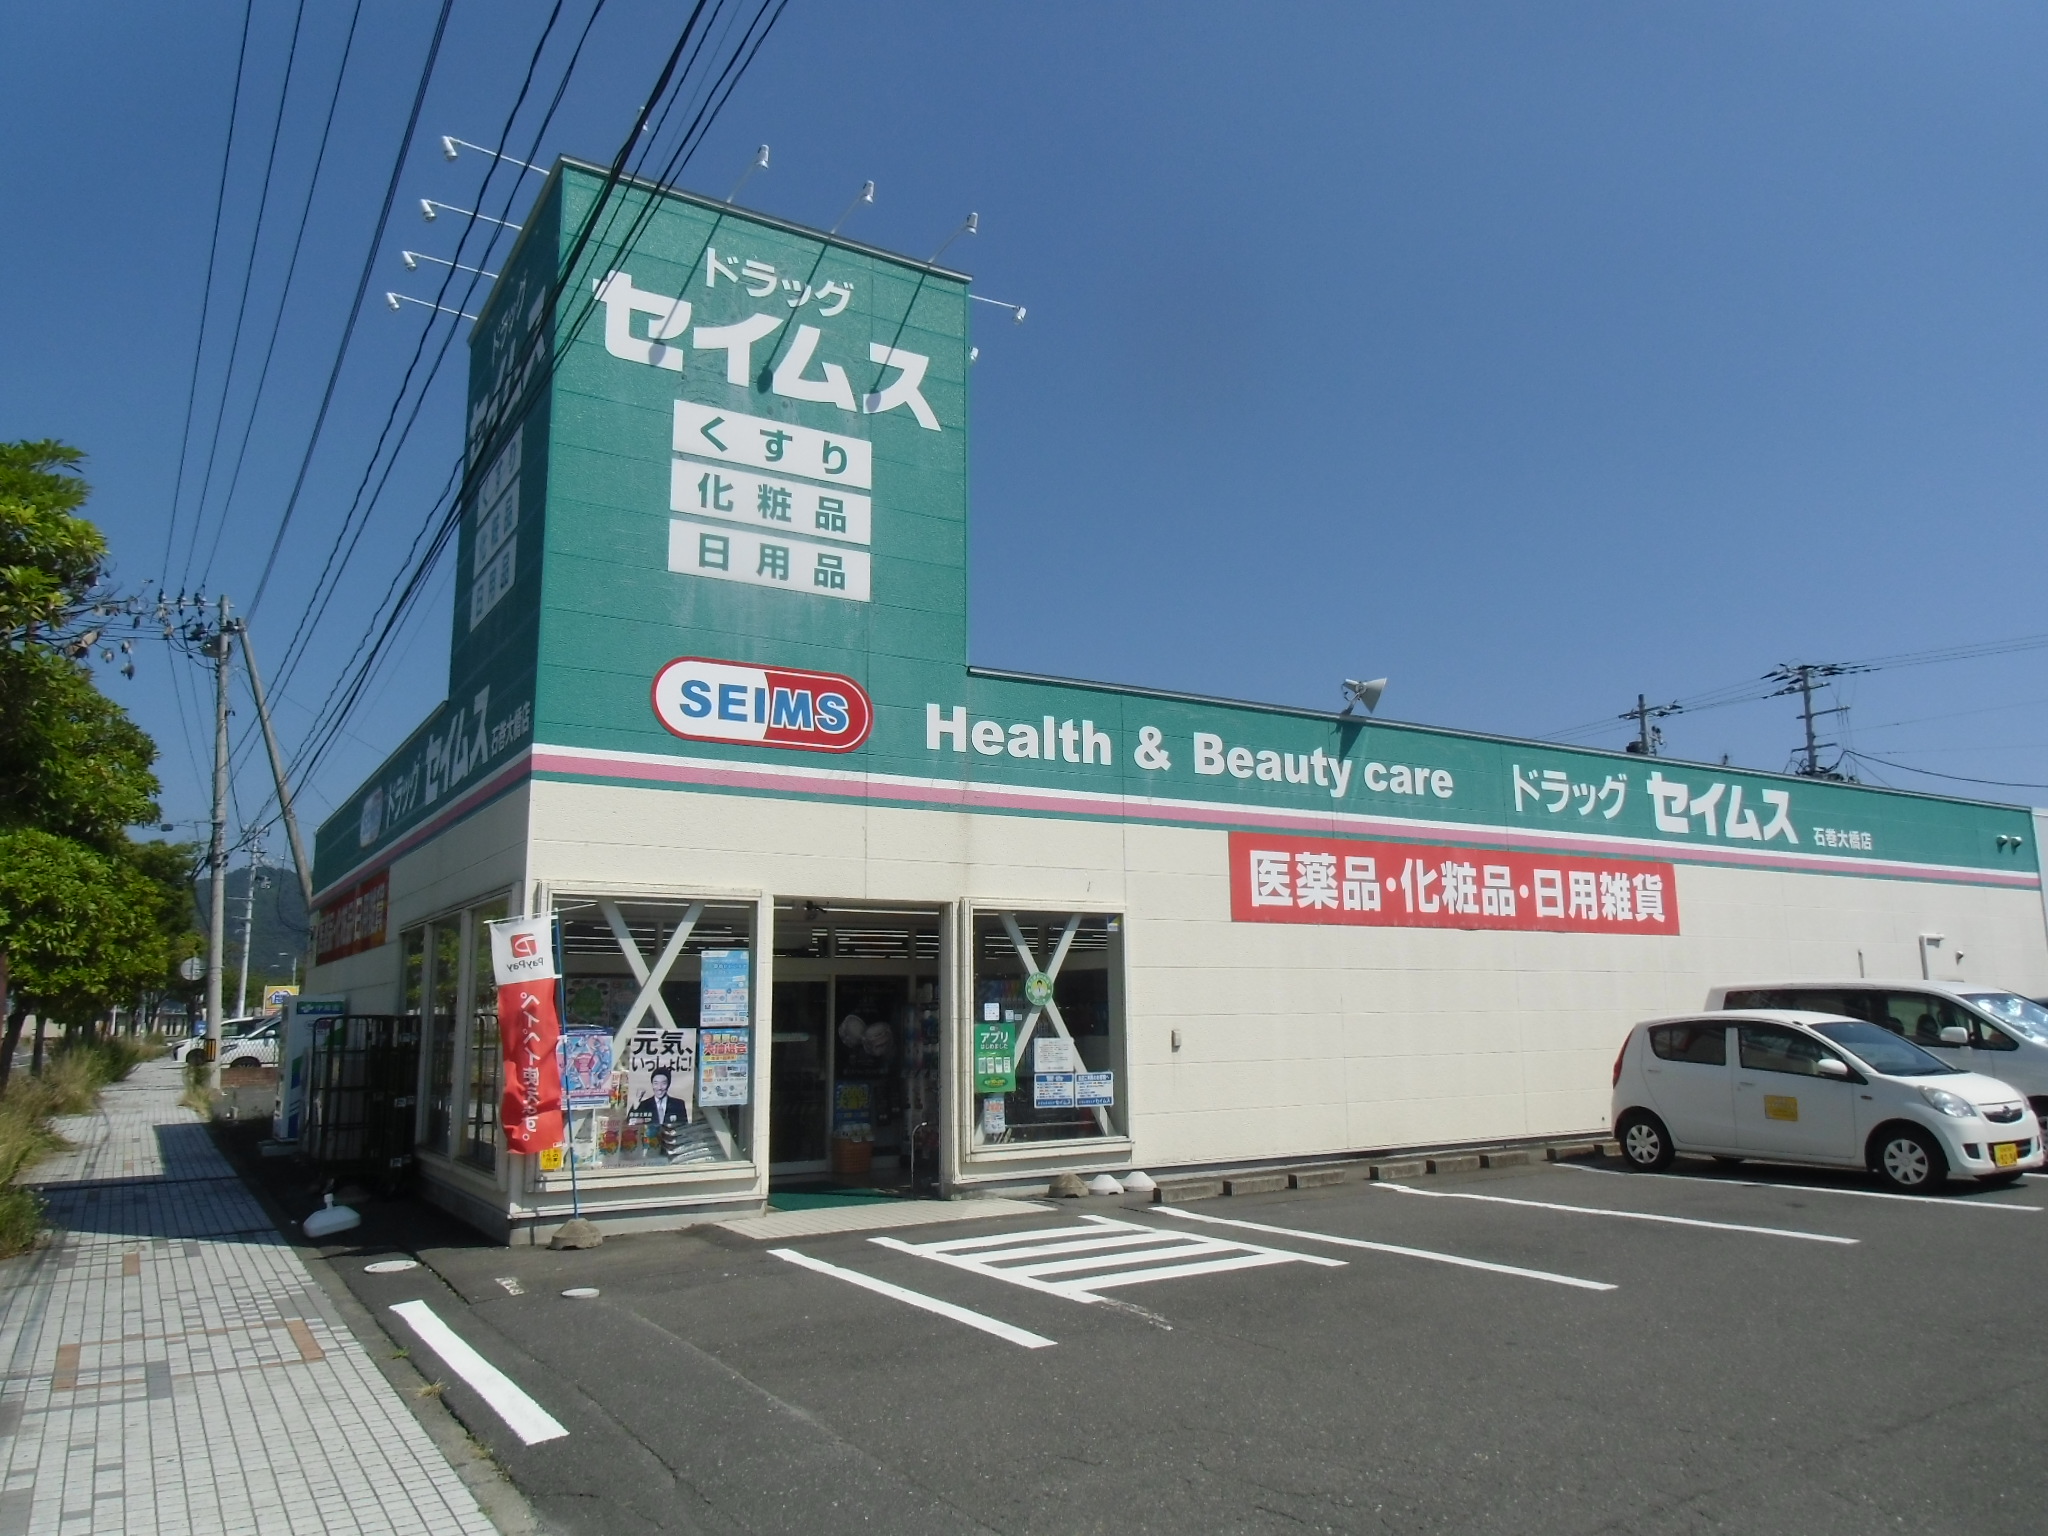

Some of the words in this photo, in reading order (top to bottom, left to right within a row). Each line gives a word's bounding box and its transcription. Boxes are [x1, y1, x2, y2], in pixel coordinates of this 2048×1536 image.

[706, 247, 854, 316] ドラッグ
[592, 269, 942, 431] セイムス
[700, 416, 848, 474] くすり
[697, 473, 847, 534] 化粧品
[698, 532, 846, 590] 日用品
[679, 679, 850, 735] SEIMS
[425, 684, 491, 806] セイムス
[926, 703, 1112, 766] Health
[1133, 725, 1172, 771] &
[1193, 732, 1352, 798] Beauty
[1363, 761, 1454, 798] care
[1512, 764, 1629, 818] ドラッグ
[1646, 771, 1800, 844] セイムス
[1249, 850, 1667, 922] 医薬品・化粧品・日用雑貨
[633, 1030, 693, 1056] 元気、
[980, 1031, 1009, 1043] アプリ
